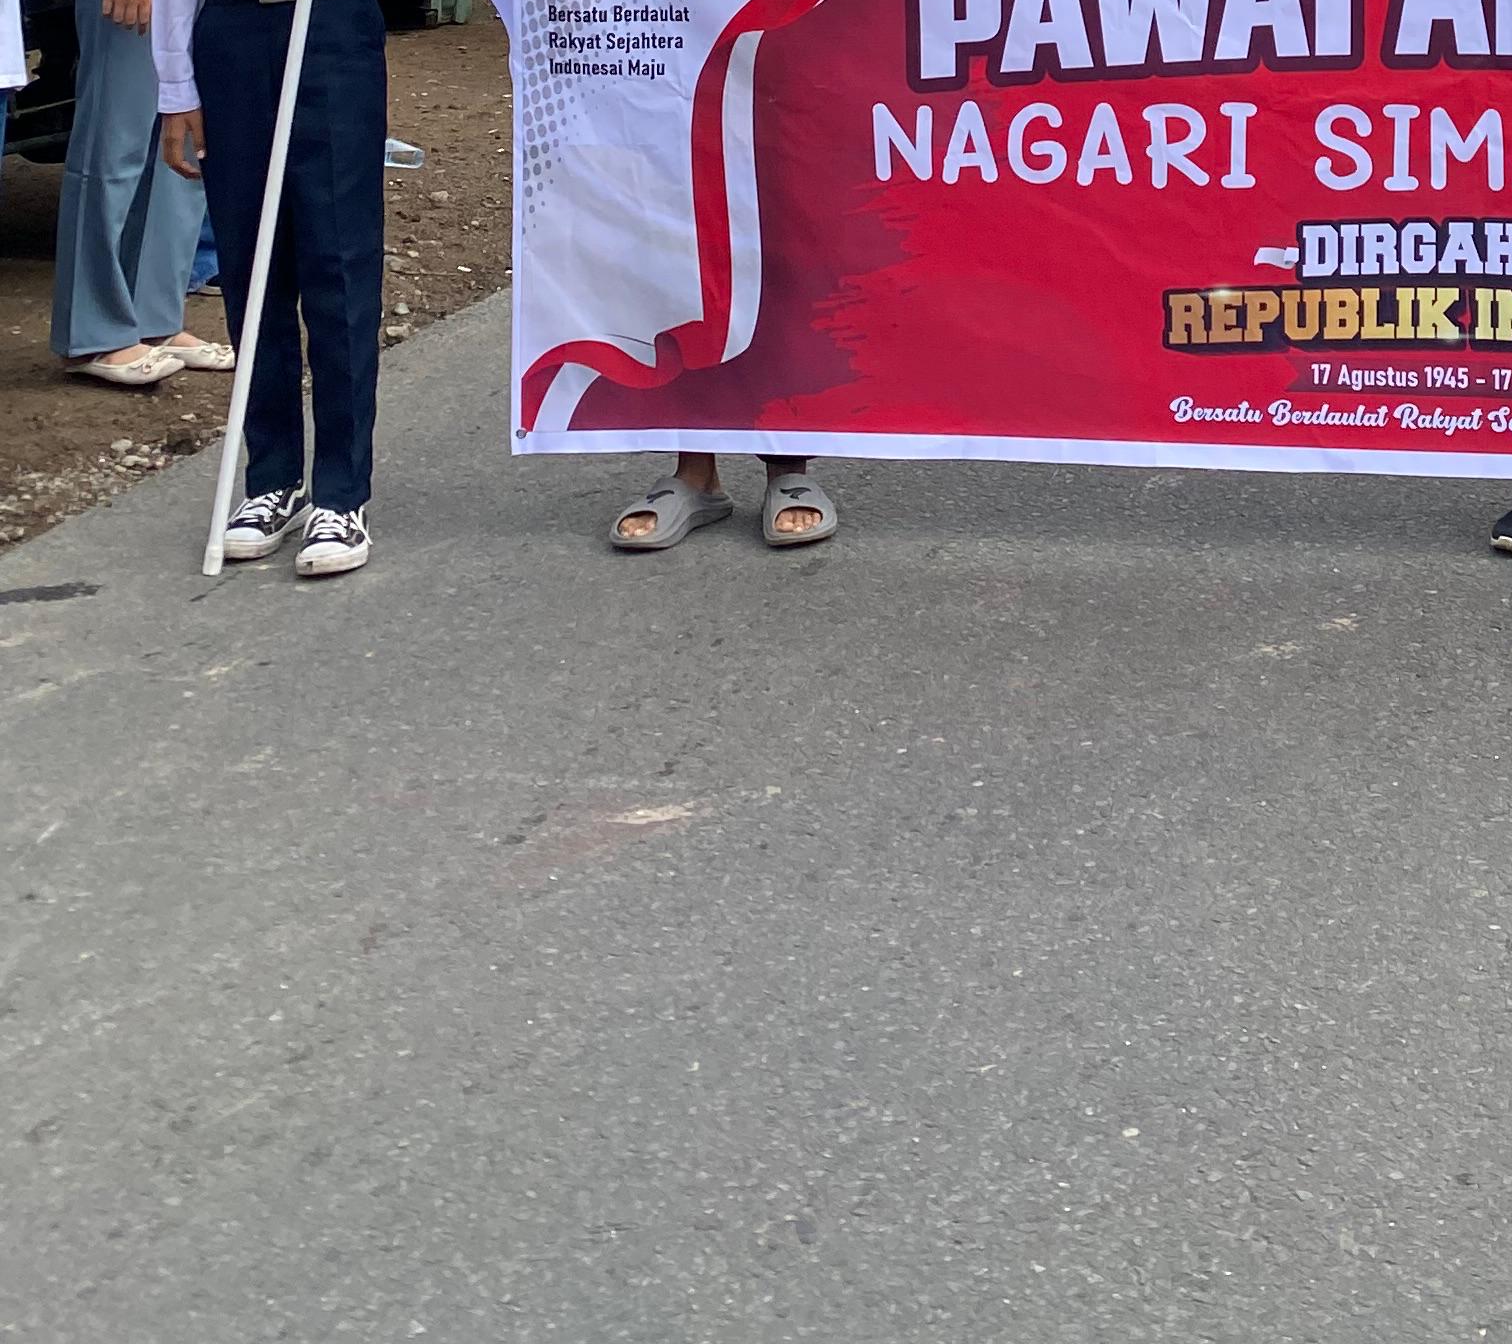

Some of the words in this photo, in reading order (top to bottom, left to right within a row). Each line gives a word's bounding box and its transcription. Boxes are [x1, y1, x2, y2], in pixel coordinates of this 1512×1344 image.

[548, 5, 608, 23] Bersatu
[613, 5, 690, 23] Berdaulat
[549, 32, 602, 54] Rakyat
[606, 32, 684, 54] Sejahtera
[549, 59, 623, 76] Indonesai
[628, 59, 666, 80] Maju
[871, 99, 1258, 190] NAGARI
[1167, 286, 1461, 345] REPUBLIK
[1310, 363, 1331, 385] 17
[1337, 364, 1419, 391] Agustus
[1424, 366, 1469, 389] 1945
[1491, 368, 1512, 391] 17
[1169, 396, 1264, 423] Bersatu
[1267, 399, 1389, 427] Berdaulat
[1393, 403, 1483, 436] Rakyat
